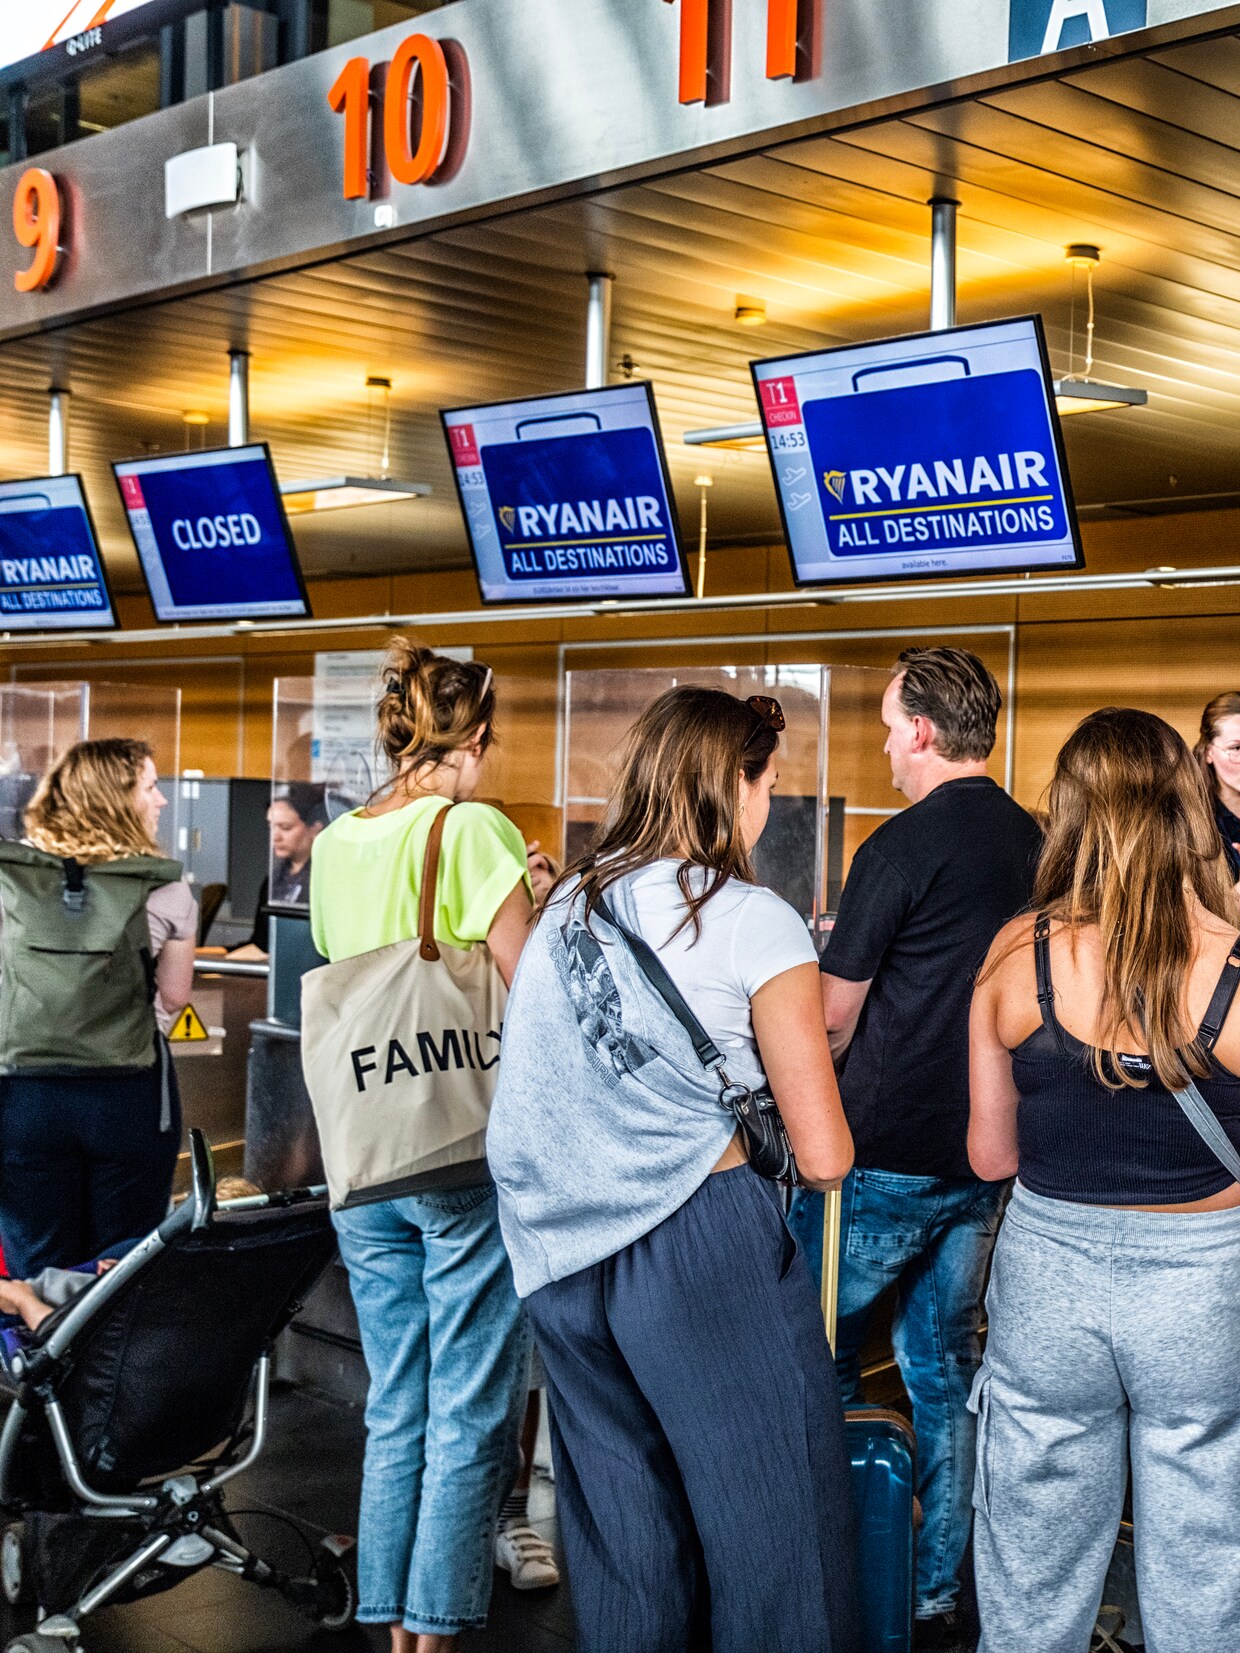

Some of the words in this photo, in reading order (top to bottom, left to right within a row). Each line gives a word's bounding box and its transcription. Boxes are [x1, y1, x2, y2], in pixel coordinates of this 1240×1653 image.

[329, 33, 450, 200] 10
[13, 167, 61, 292] 9
[766, 381, 788, 404] T1
[771, 431, 805, 450] 14:53
[850, 451, 1049, 505] RYANAIR
[172, 513, 262, 551] CLOSED
[517, 495, 663, 537] RYANAIR
[838, 522, 879, 547] ALL
[884, 505, 1054, 543] DESTINATIONS
[2, 554, 96, 583] RYANAIR
[512, 551, 543, 573] ALL
[545, 543, 669, 571] DESTINATIONS
[902, 559, 932, 569] available
[1, 594, 22, 609] ALL
[22, 589, 103, 609] DESTINATIONS
